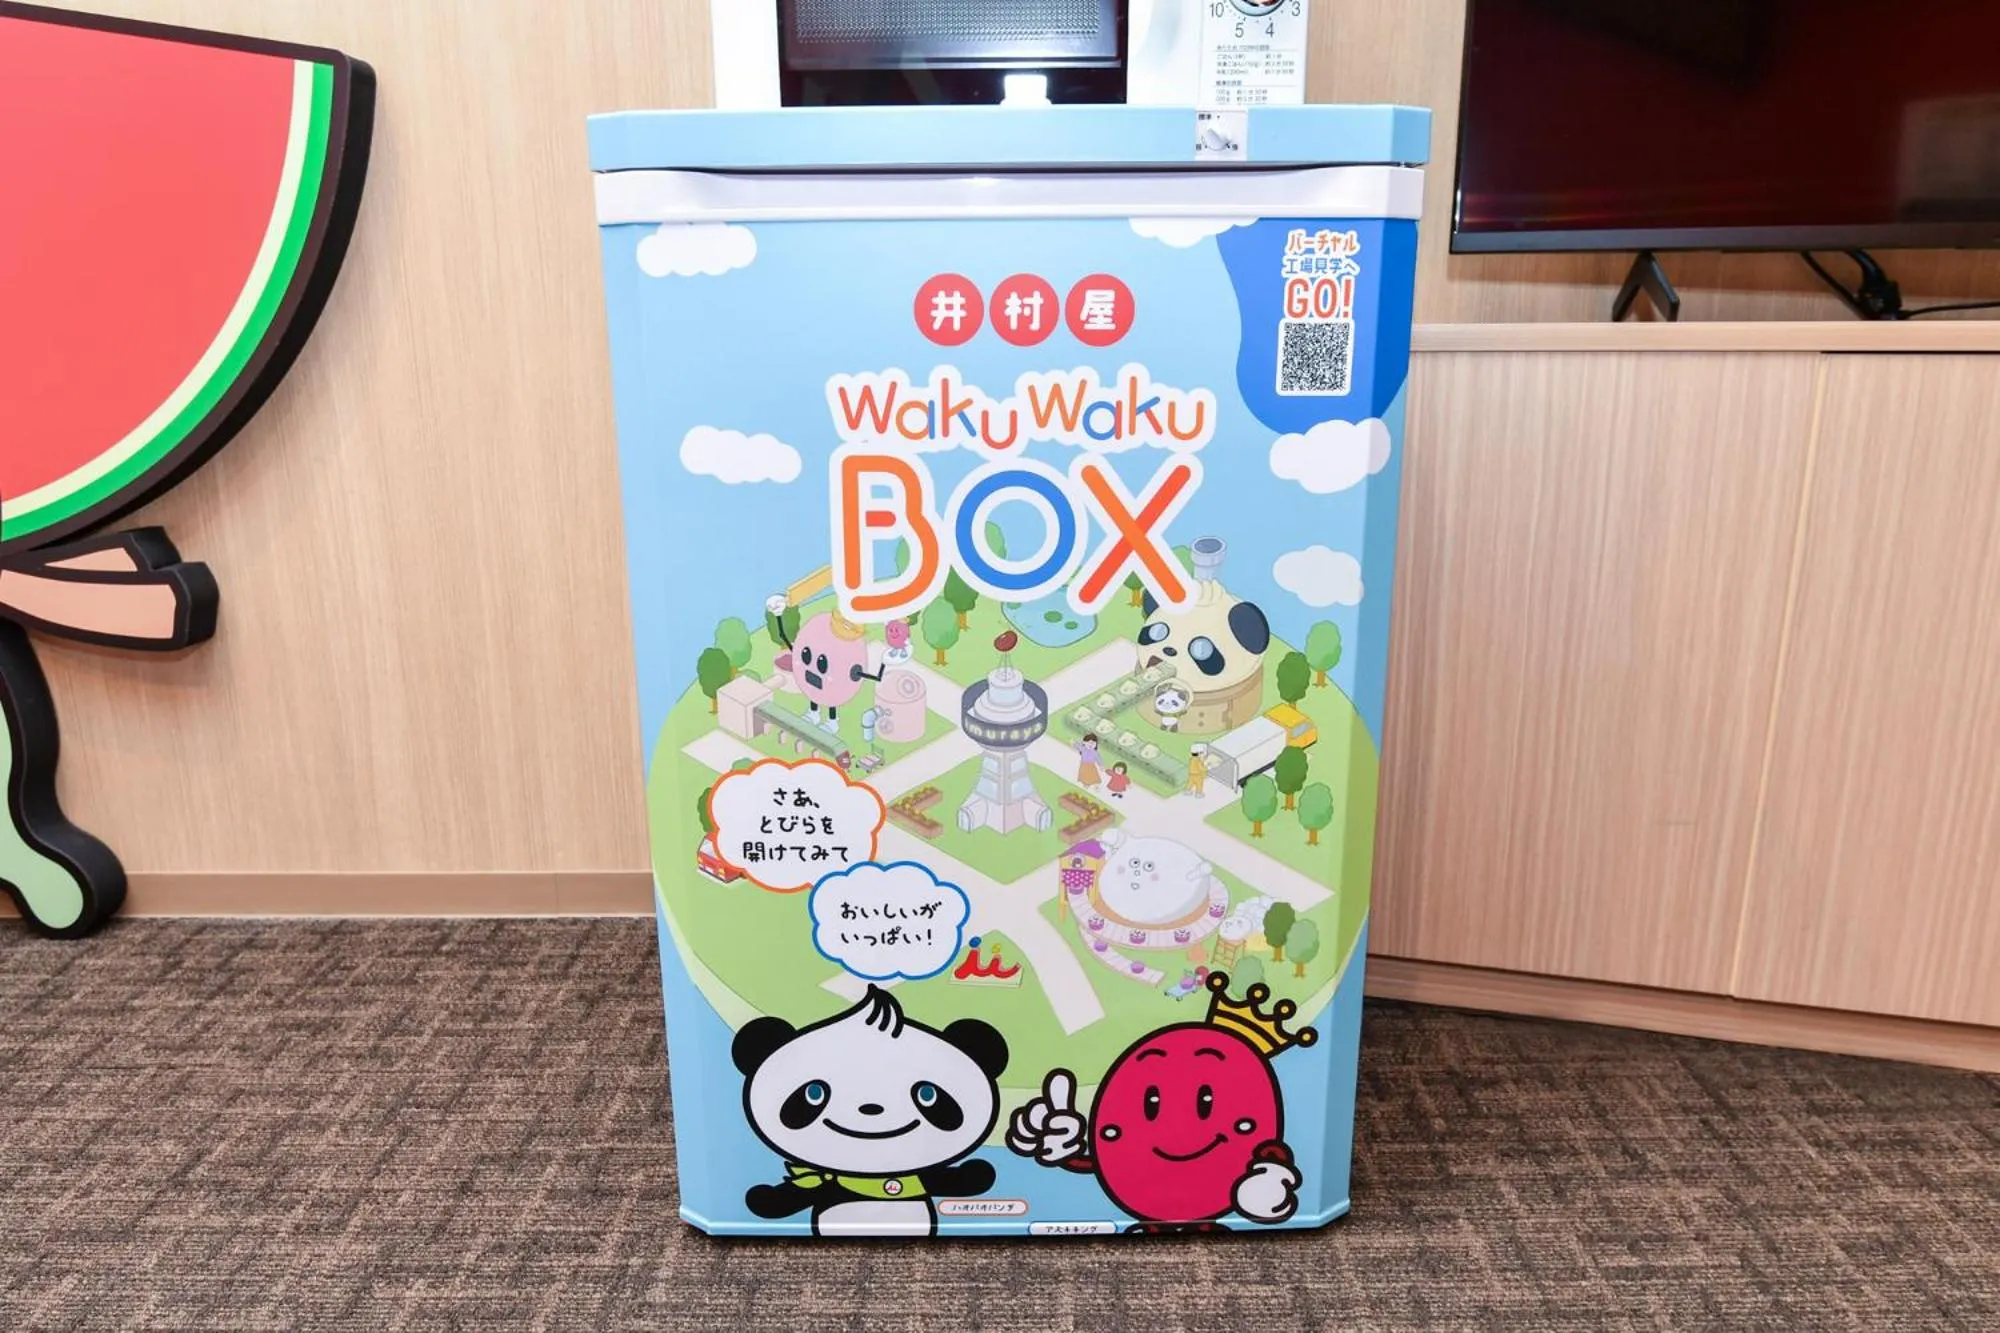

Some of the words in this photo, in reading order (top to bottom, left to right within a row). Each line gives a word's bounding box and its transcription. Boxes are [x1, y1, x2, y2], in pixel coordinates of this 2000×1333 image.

[1210, 2, 1224, 18] 10
[1292, 1, 1301, 17] 3
[1235, 22, 1244, 38] 5
[1265, 22, 1274, 38] 4
[1288, 232, 1357, 252] バーチャル
[1285, 257, 1357, 274] 工場見学へ
[1287, 278, 1353, 319] GO!
[929, 289, 1117, 332] 井村屋
[838, 377, 1018, 450] Waku
[1027, 375, 1205, 441] Waku
[841, 454, 1192, 612] BOX
[772, 787, 821, 809] さあ、
[759, 815, 835, 835] とびらを
[742, 841, 849, 863] 開けてみて
[840, 901, 943, 920] おいしいが
[840, 926, 933, 946] いっぱい!
